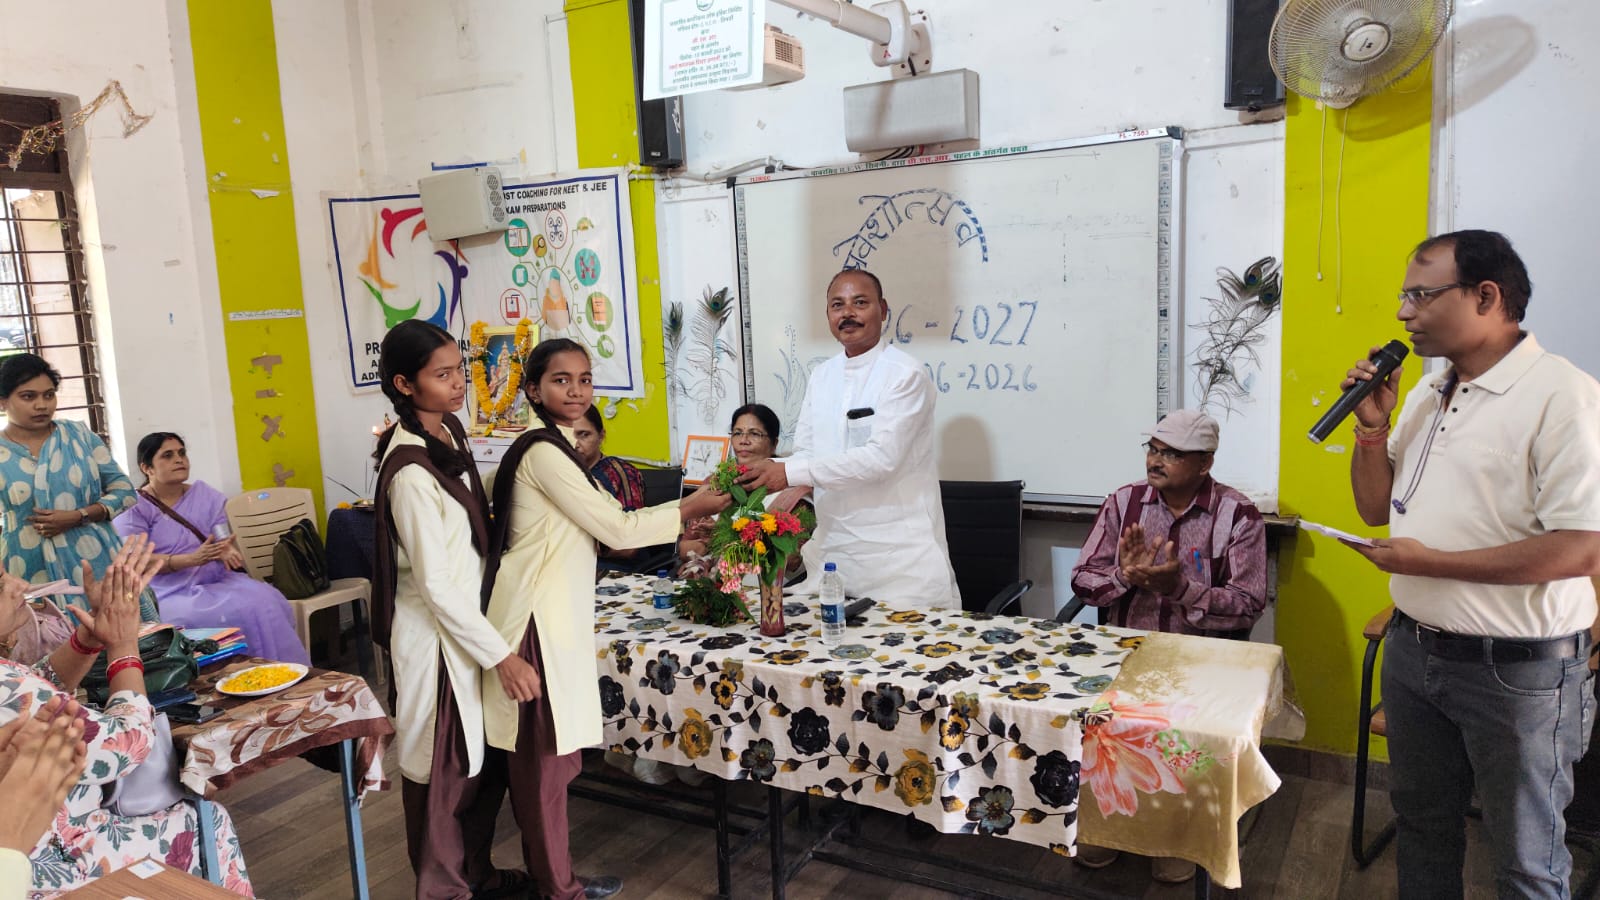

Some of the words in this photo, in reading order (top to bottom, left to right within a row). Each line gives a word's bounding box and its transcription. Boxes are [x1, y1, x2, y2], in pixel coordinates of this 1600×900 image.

[516, 187, 548, 200] COACHING
[549, 186, 562, 197] FOR
[562, 184, 580, 195] NEET
[582, 183, 588, 192] &
[590, 181, 608, 192] JEE
[505, 205, 521, 215] XAM
[522, 201, 567, 214] PREPARATIONS
[950, 300, 1039, 346] 2027
